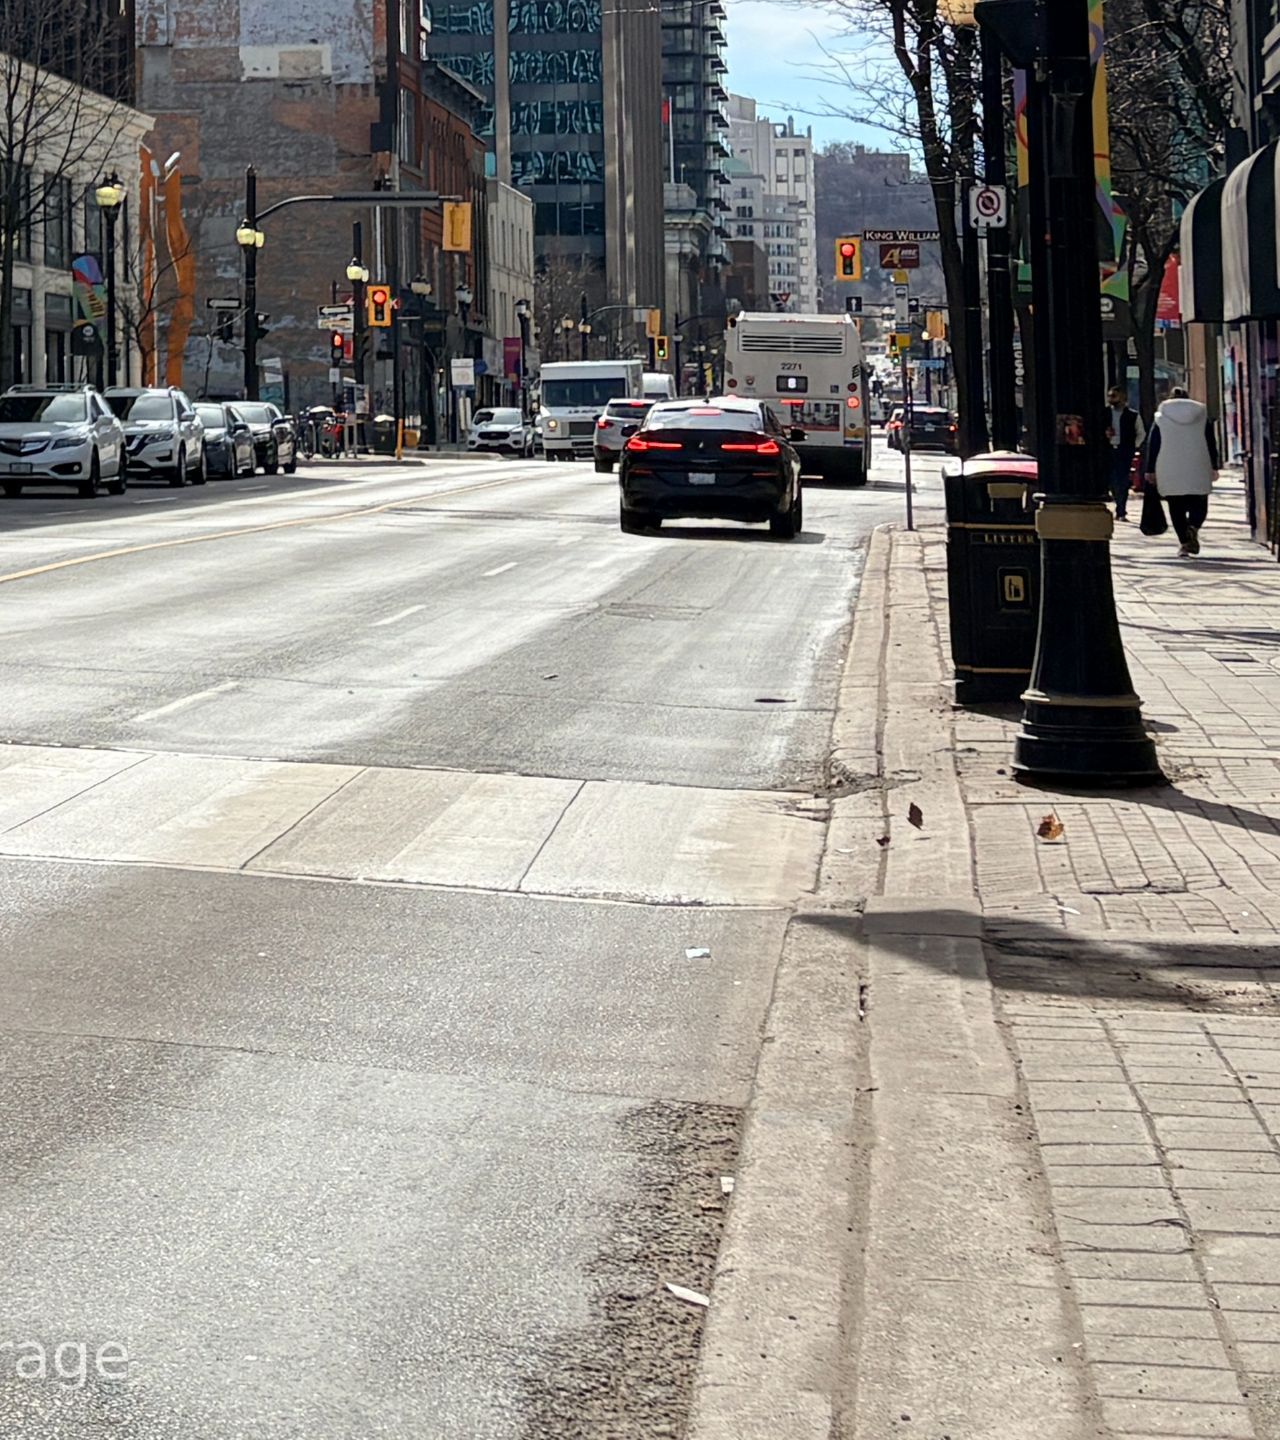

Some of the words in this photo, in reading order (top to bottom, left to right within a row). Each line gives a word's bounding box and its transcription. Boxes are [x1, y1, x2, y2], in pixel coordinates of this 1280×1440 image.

[865, 231, 894, 241] KING
[780, 362, 803, 371] 2271
[983, 533, 1035, 545] LITTER
